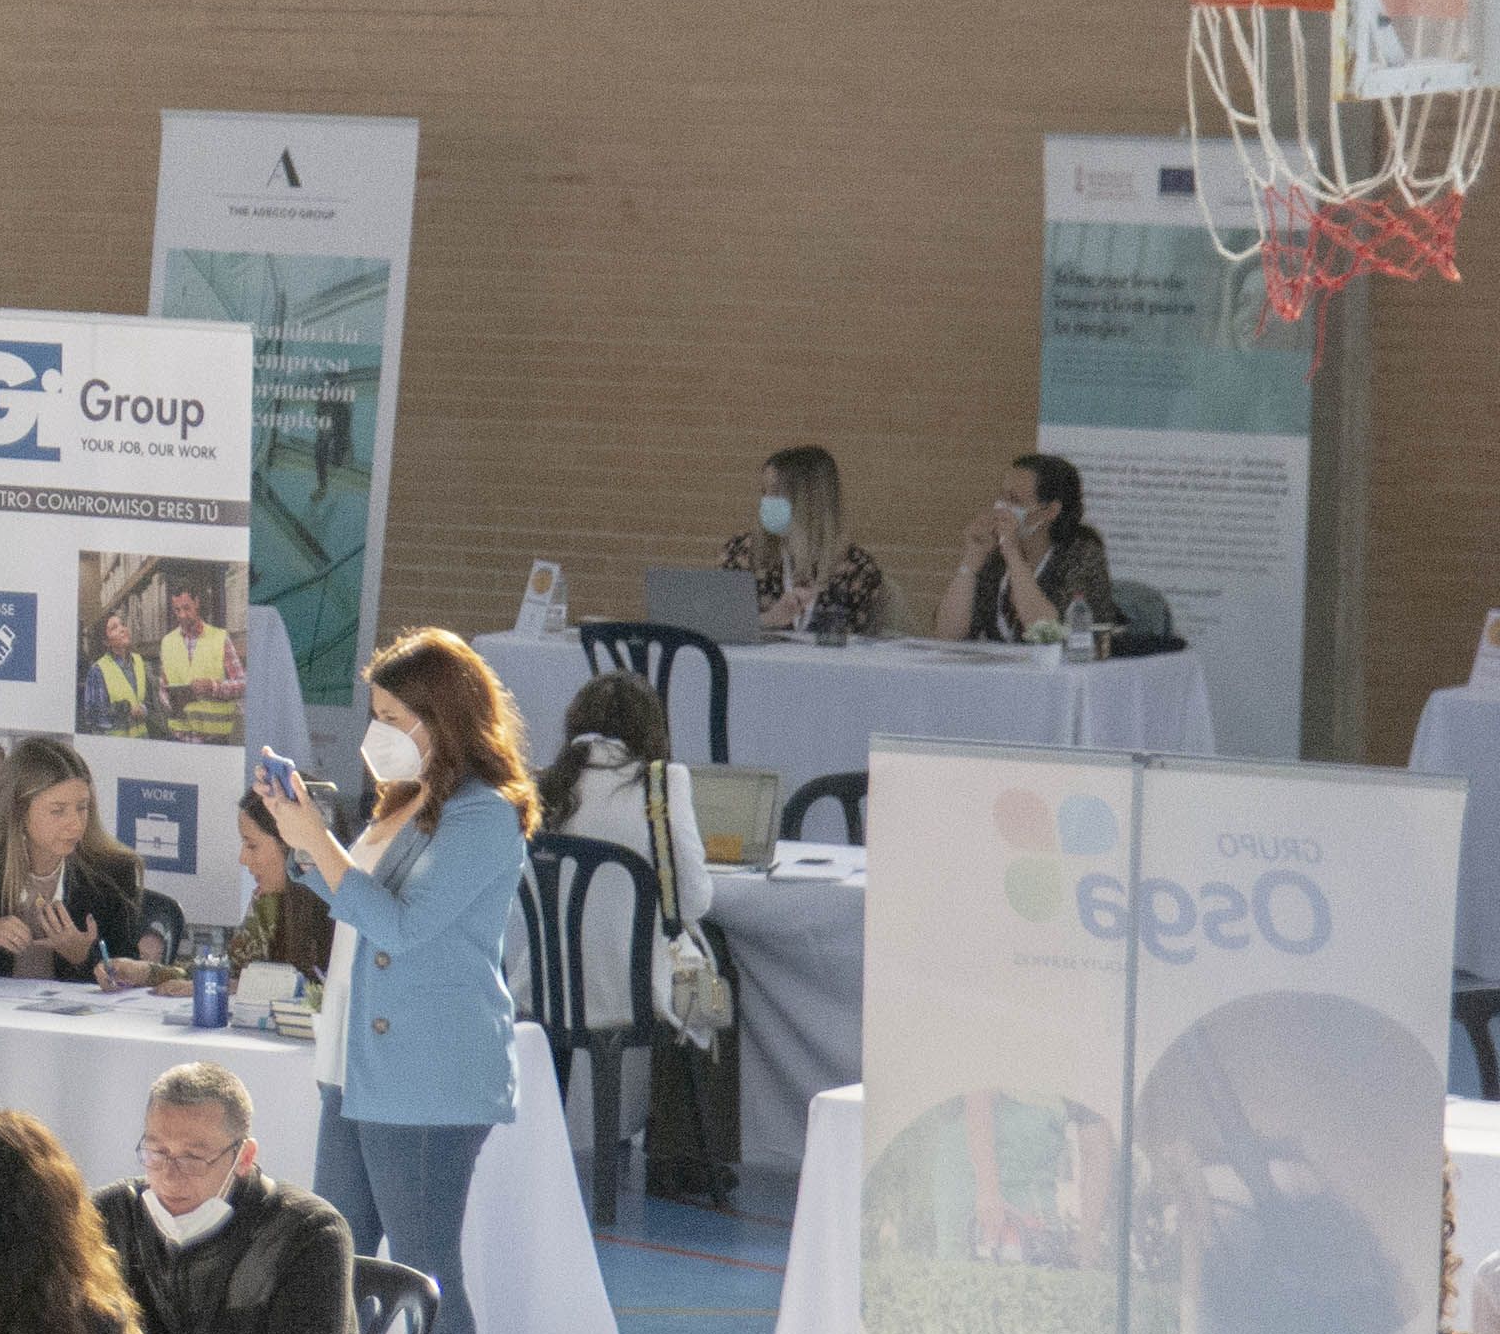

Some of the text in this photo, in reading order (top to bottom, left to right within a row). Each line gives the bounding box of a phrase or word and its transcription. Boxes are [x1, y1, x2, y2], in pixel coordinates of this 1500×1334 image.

[80, 379, 205, 440] Group
[80, 438, 217, 460] YOUR JOB, OUR WORK
[35, 492, 155, 517] COMPROMISO
[158, 501, 194, 520] ERES
[198, 500, 219, 522] TÚ
[141, 788, 177, 802] WORK
